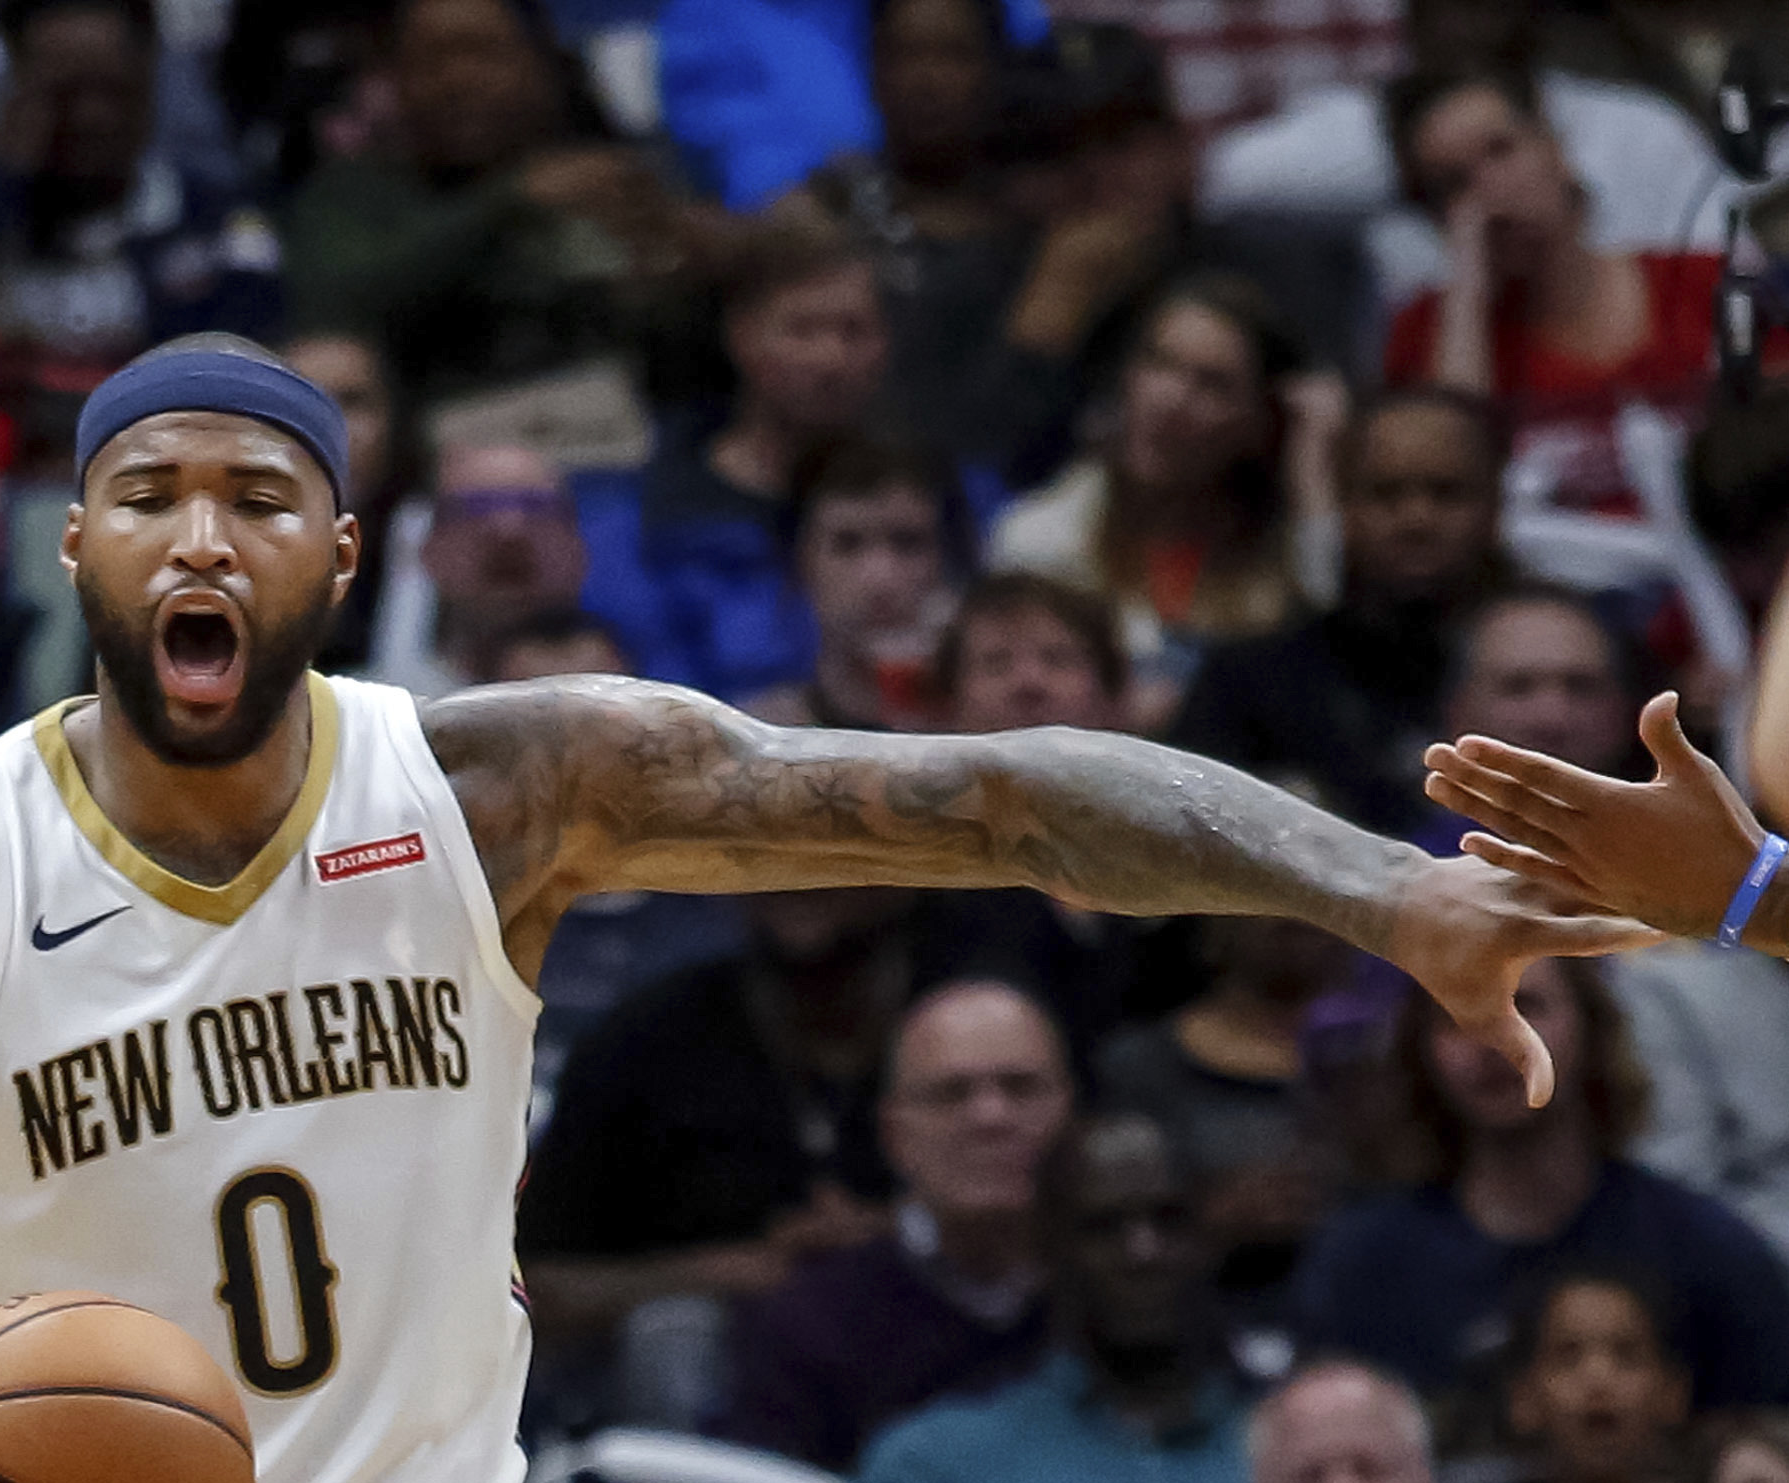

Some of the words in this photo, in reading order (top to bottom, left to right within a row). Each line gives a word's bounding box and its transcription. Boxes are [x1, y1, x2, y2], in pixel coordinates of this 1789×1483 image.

[13, 1018, 174, 1181] NEW
[189, 977, 469, 1119] ORLEANS
[212, 1164, 340, 1399] 0
